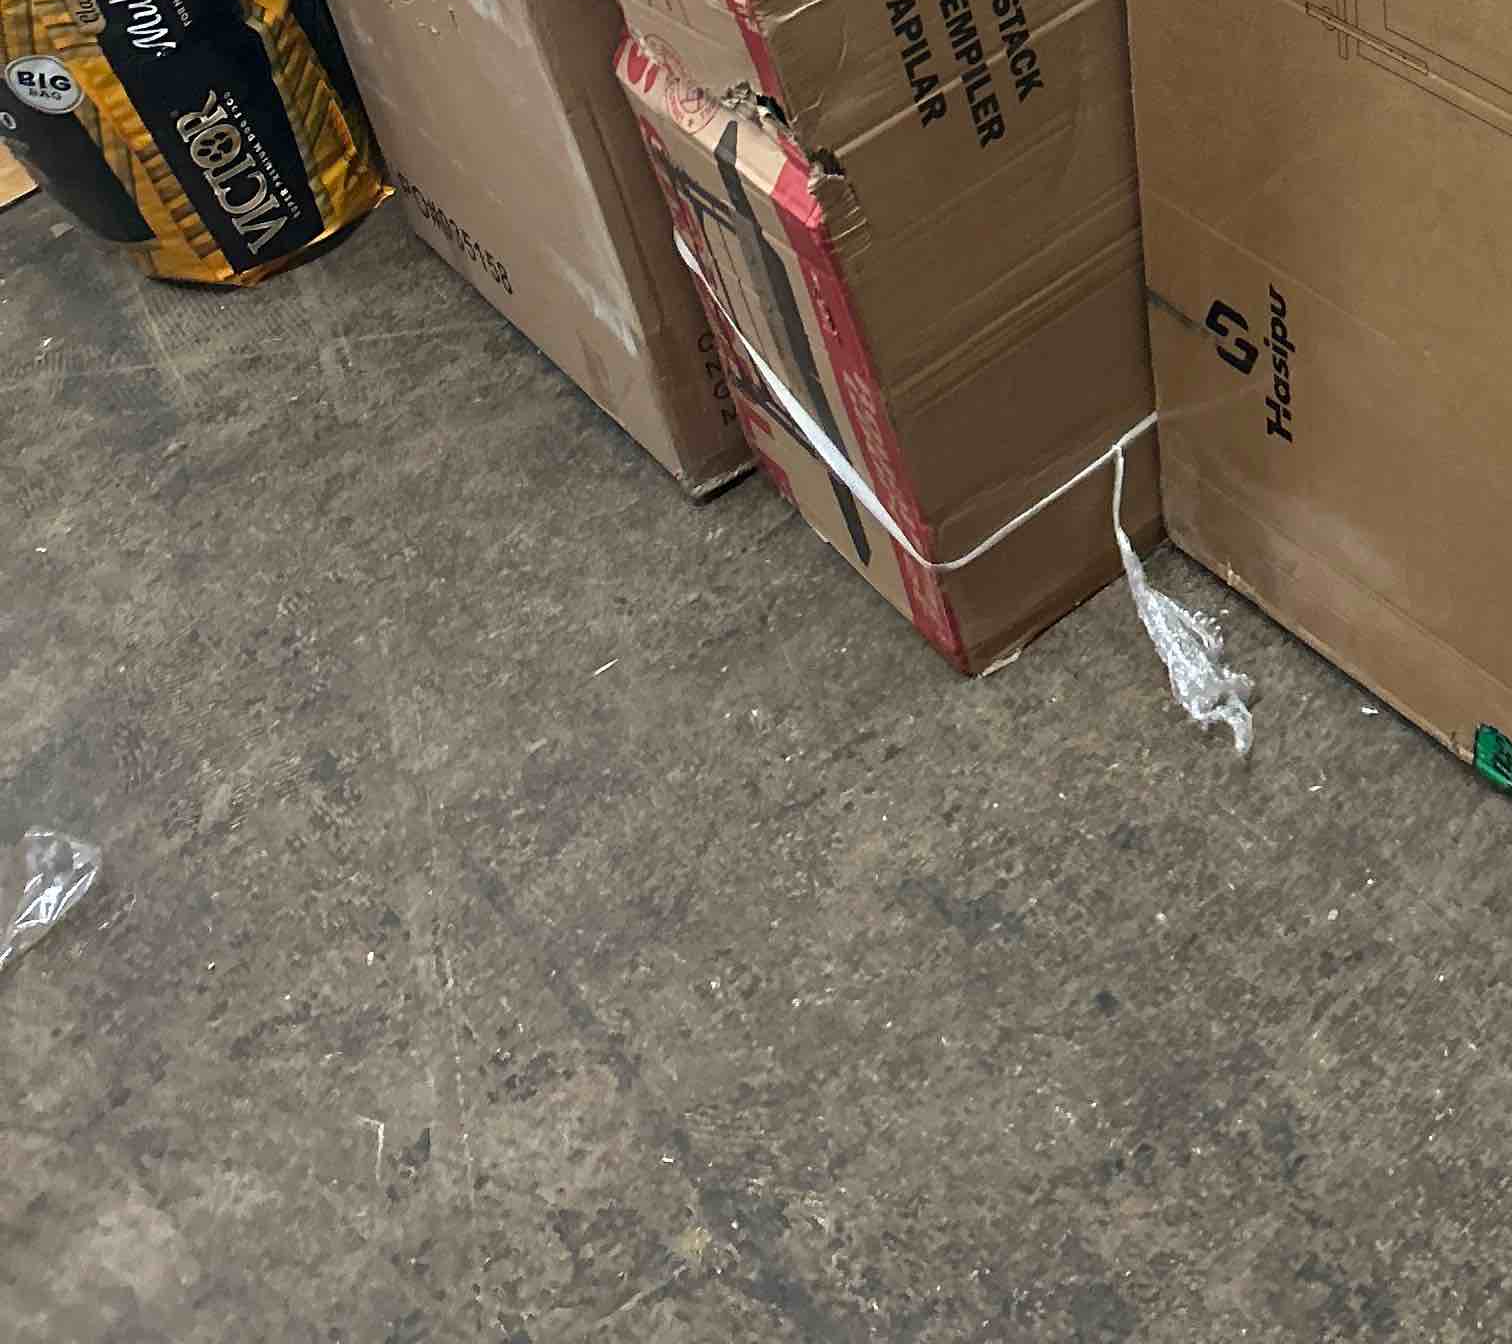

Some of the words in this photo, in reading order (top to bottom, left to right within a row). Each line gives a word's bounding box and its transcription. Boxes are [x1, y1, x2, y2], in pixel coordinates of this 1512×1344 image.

[177, 8, 192, 28] FOR
[18, 71, 72, 92] BIG
[29, 90, 62, 101] BAG
[177, 89, 288, 255] VICTOR
[1266, 284, 1297, 444] Hasipu
